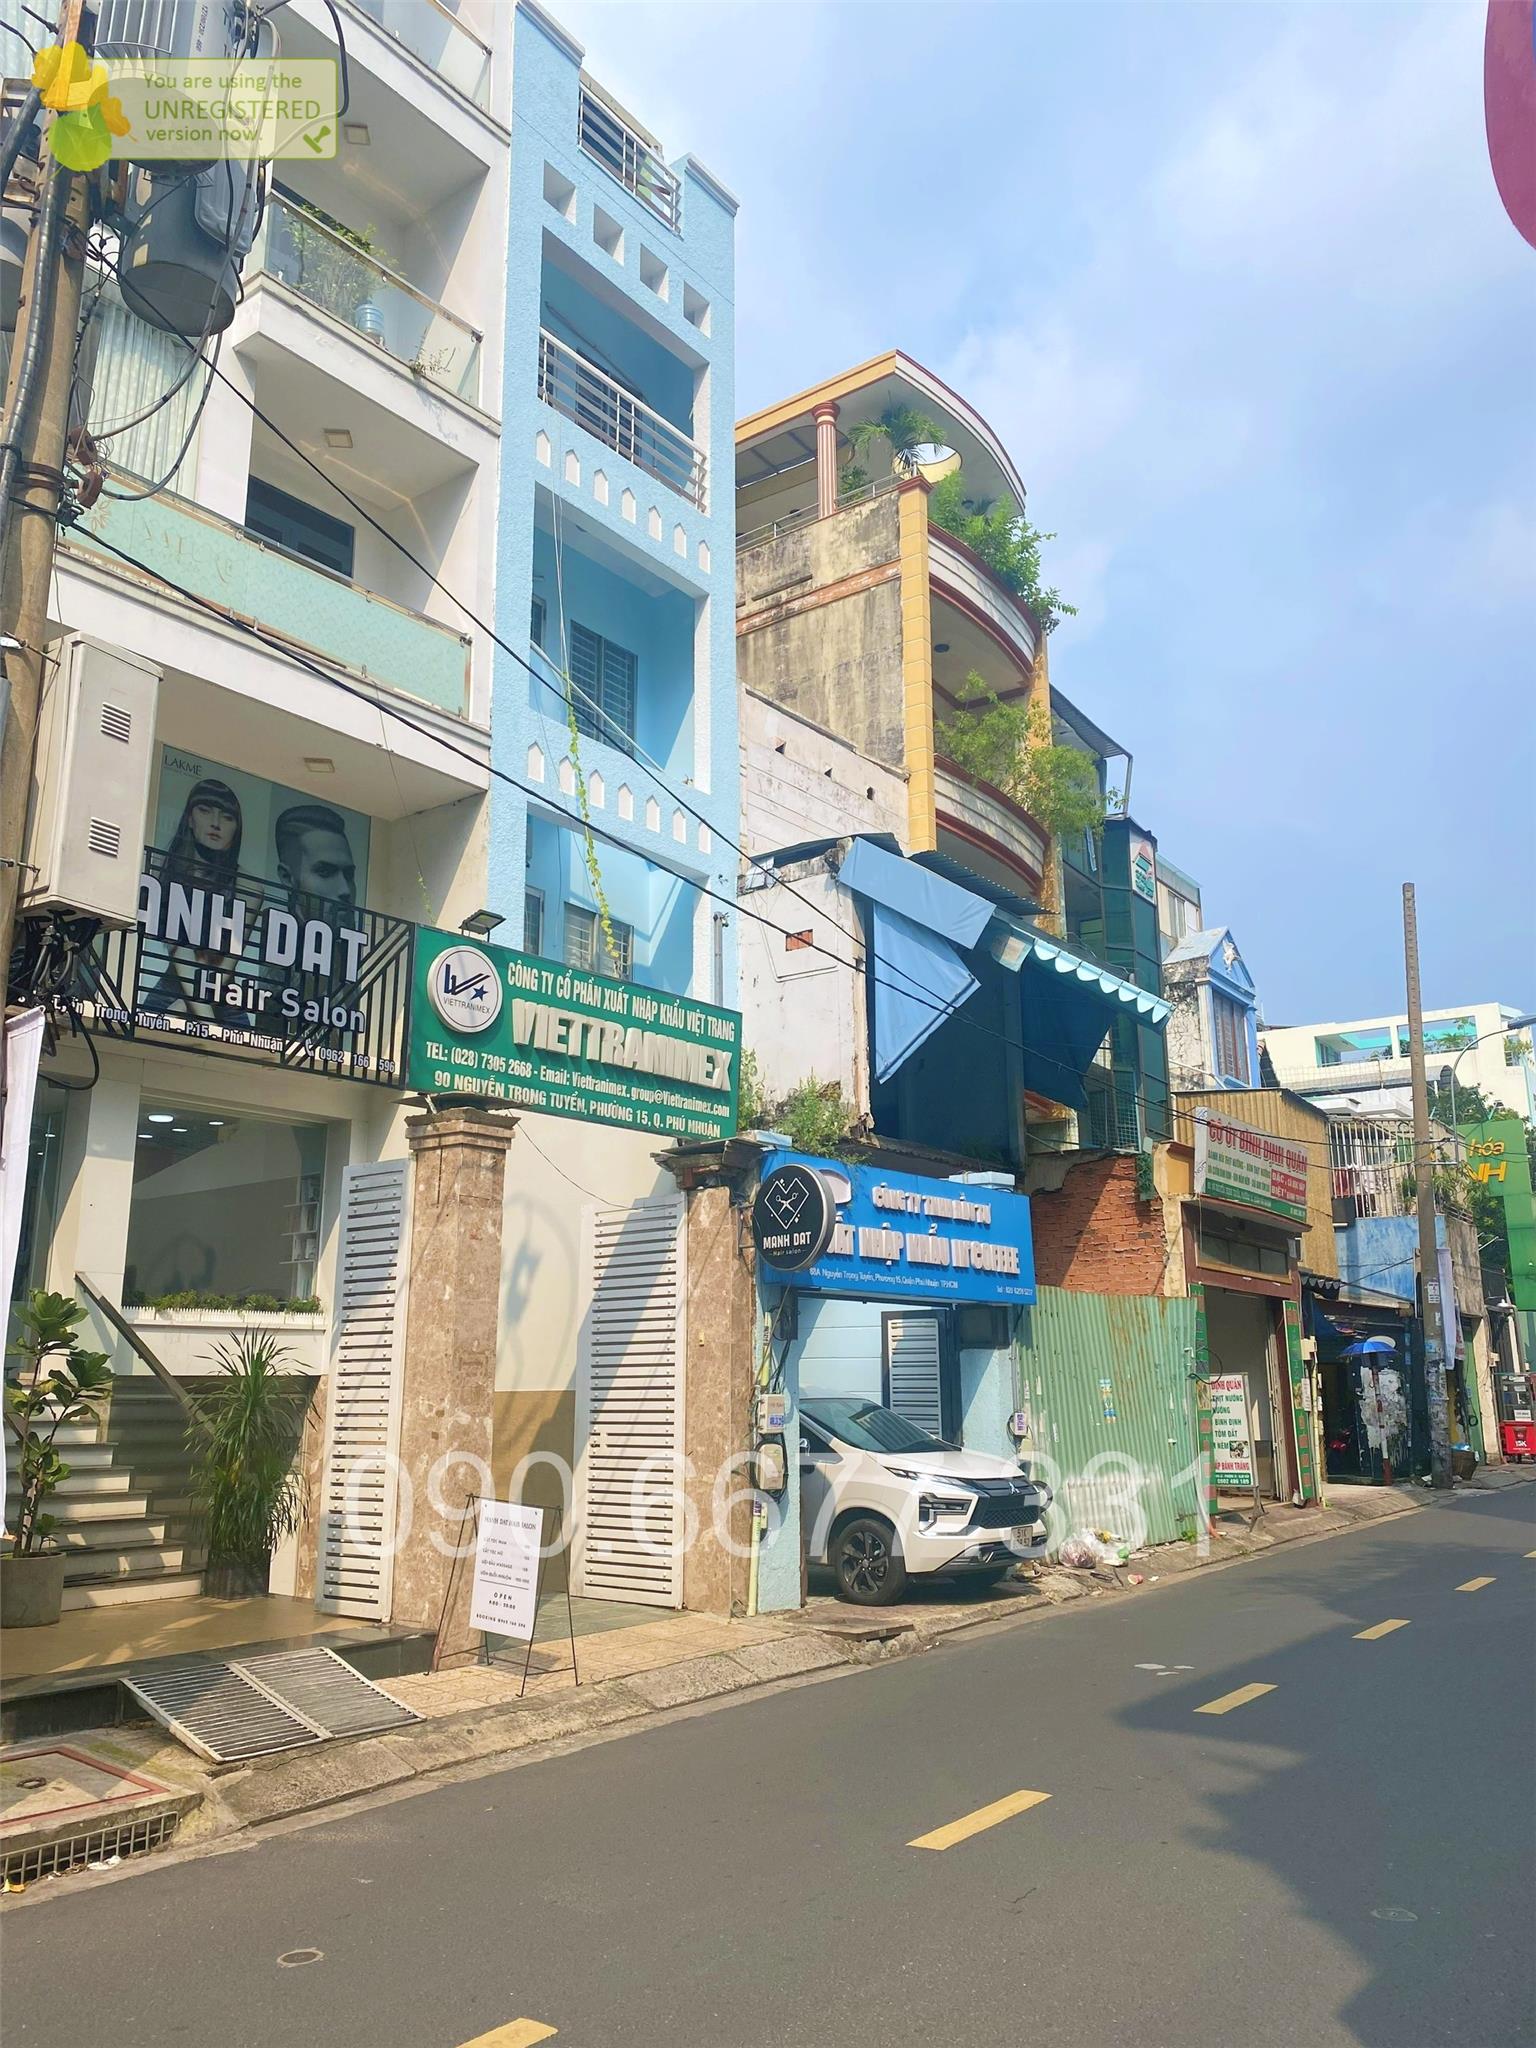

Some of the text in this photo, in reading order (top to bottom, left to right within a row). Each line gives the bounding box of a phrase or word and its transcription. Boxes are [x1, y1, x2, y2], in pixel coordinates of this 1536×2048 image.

[136, 872, 246, 956] ANH
[200, 969, 366, 1033] Hair Salon
[443, 996, 491, 1015] VIETTRANIMEX
[507, 959, 735, 1042] CÔNG TY CỔ PHẦN XUẤT NHẬP KHẨU VIỆT TRANG
[320, 1048, 344, 1064] 0962
[353, 1054, 370, 1068] 166
[378, 1059, 395, 1074] 596
[426, 1041, 448, 1061] TEL:
[451, 1046, 478, 1069] (028)
[481, 1053, 506, 1073] 7305
[508, 1059, 532, 1078] 2668
[540, 1065, 570, 1086] Email:
[511, 997, 733, 1091] VIETTRANIMEX
[434, 1071, 450, 1087] 90
[453, 1074, 504, 1098] NGUYỄN
[636, 1109, 651, 1127] 15,
[653, 1113, 664, 1128] Q.
[666, 1114, 685, 1131] PHÚ
[1468, 1136, 1505, 1157] hóa
[763, 1231, 811, 1250] MANH DAT
[493, 1592, 513, 1601] OPEN
